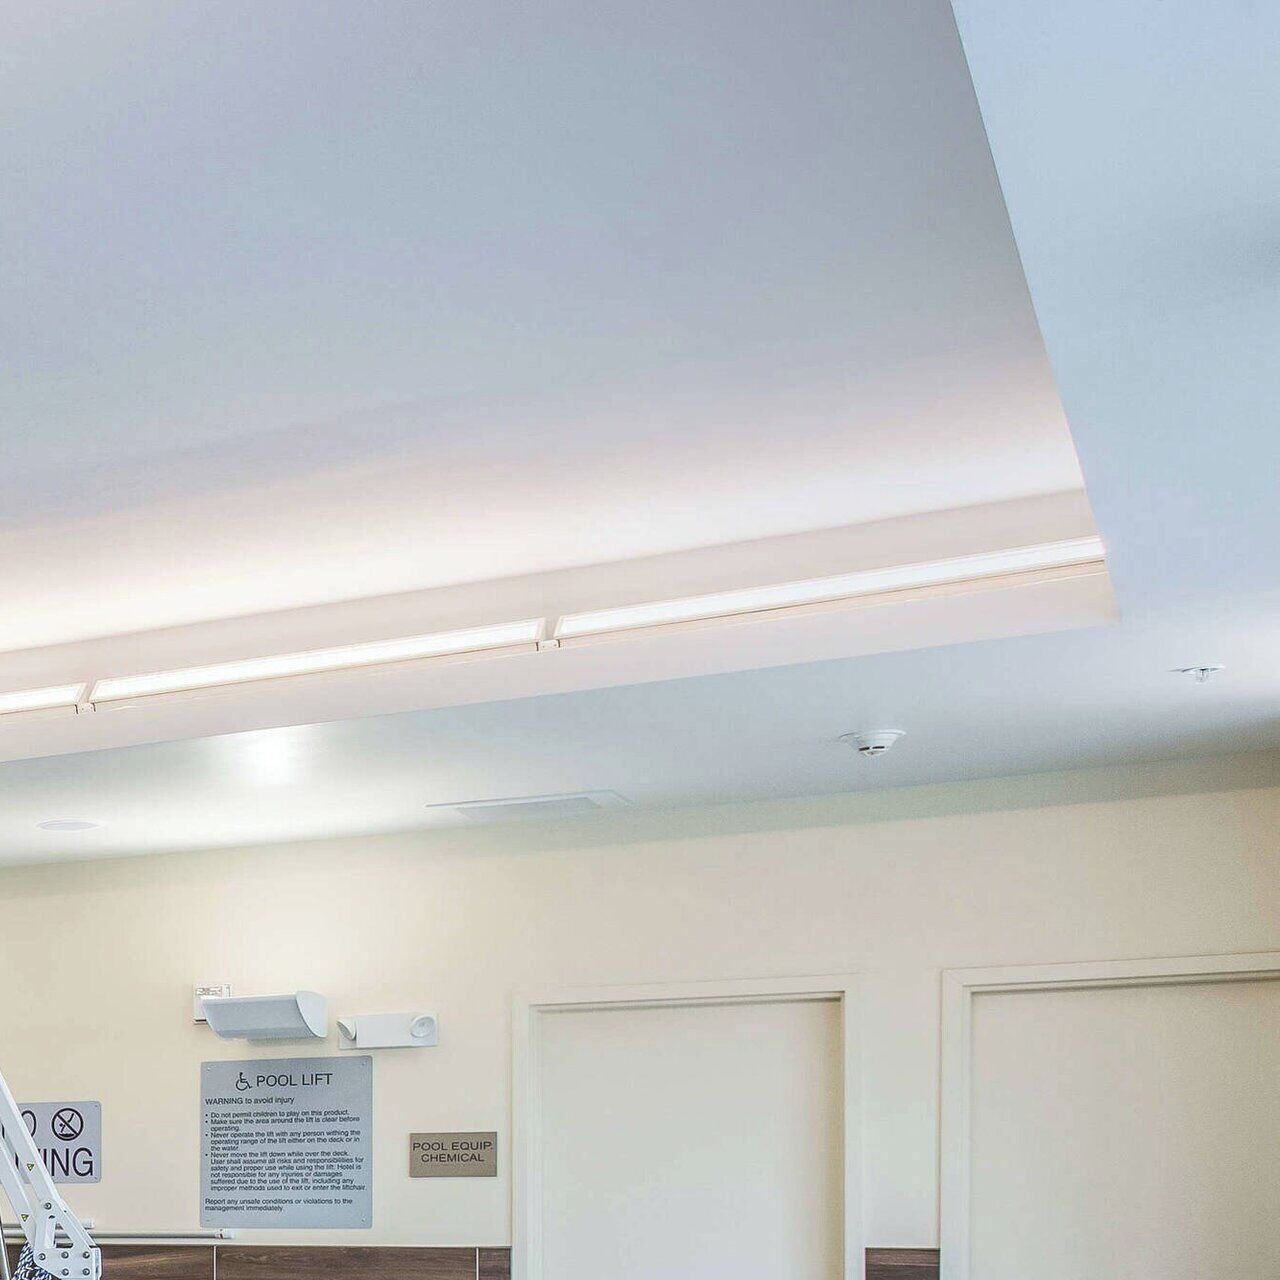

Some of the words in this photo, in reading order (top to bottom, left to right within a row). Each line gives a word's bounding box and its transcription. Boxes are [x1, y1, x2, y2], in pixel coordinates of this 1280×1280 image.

[256, 1074, 298, 1087] POOL
[302, 1073, 333, 1086] LIFT
[205, 1097, 243, 1105] WARNING
[275, 1096, 295, 1105] injury
[412, 1142, 448, 1151] POOL
[451, 1141, 493, 1151] EQUIP.
[421, 1153, 484, 1163] CHEMICAL
